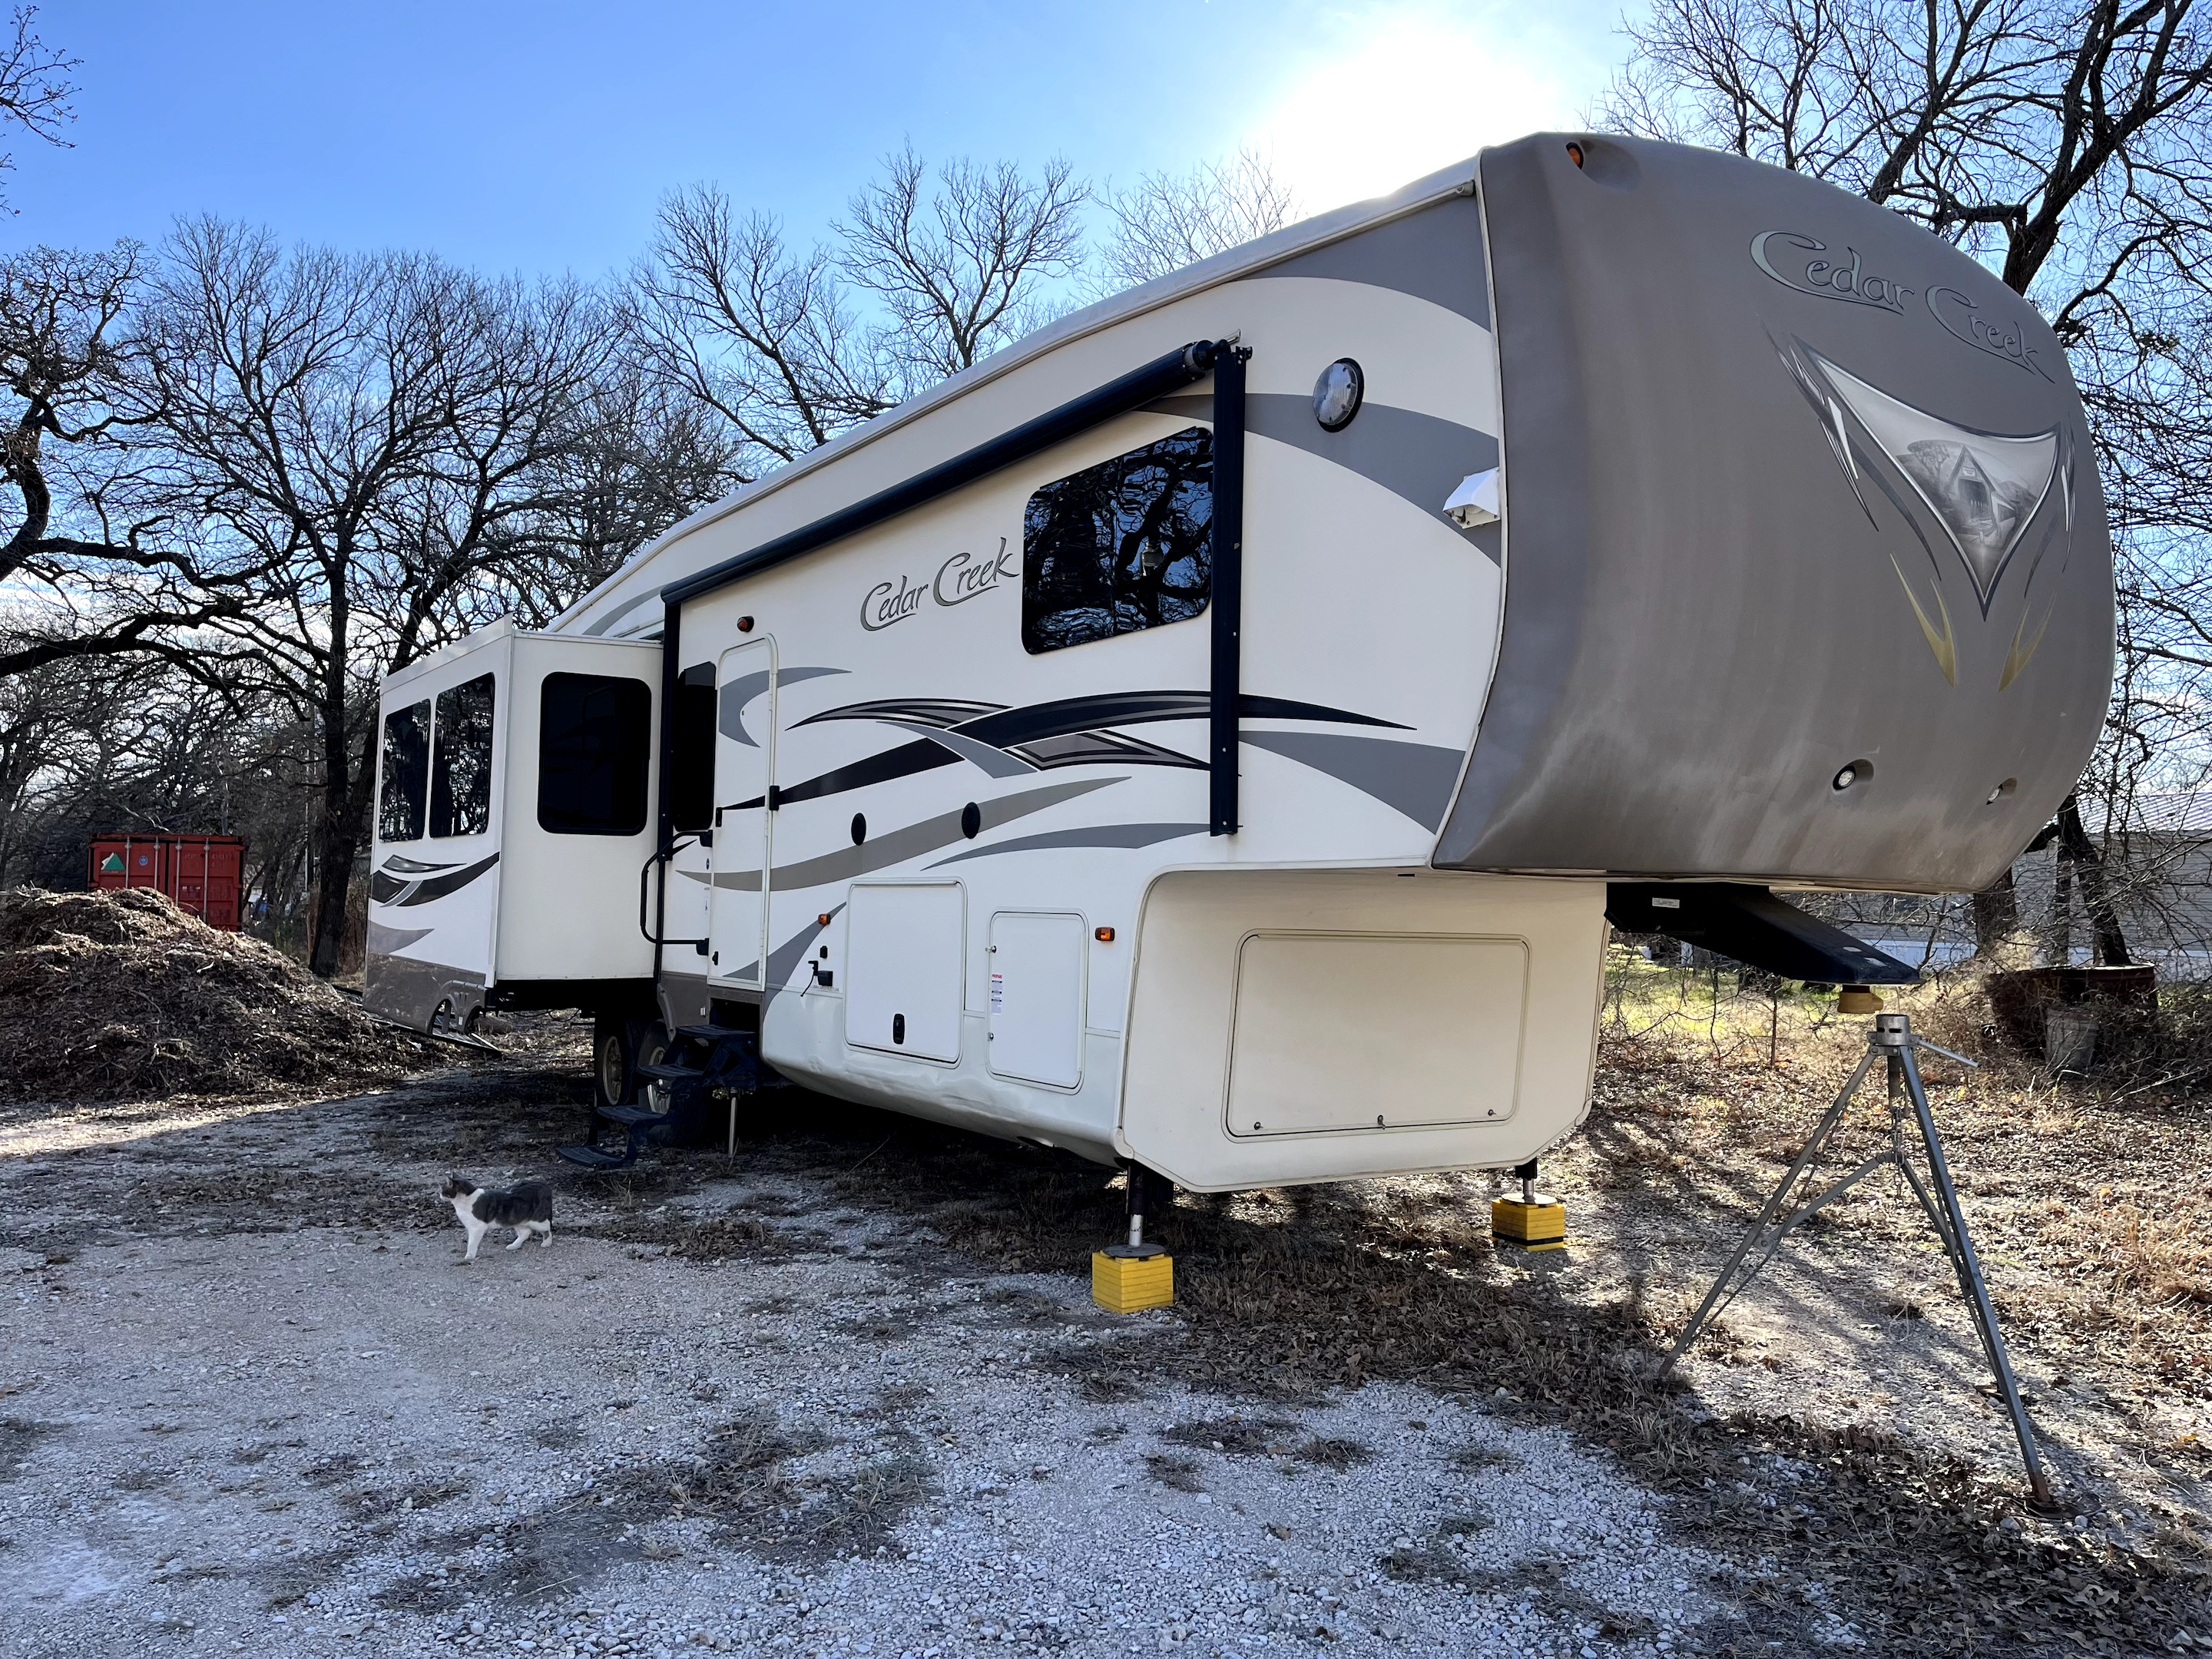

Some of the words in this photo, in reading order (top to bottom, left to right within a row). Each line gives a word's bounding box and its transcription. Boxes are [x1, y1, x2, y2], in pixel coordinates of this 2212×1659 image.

[1750, 230, 1916, 316] Cedar
[1925, 284, 2056, 384] Creek
[859, 575, 929, 631] Cedar
[932, 536, 1021, 607] Creek
